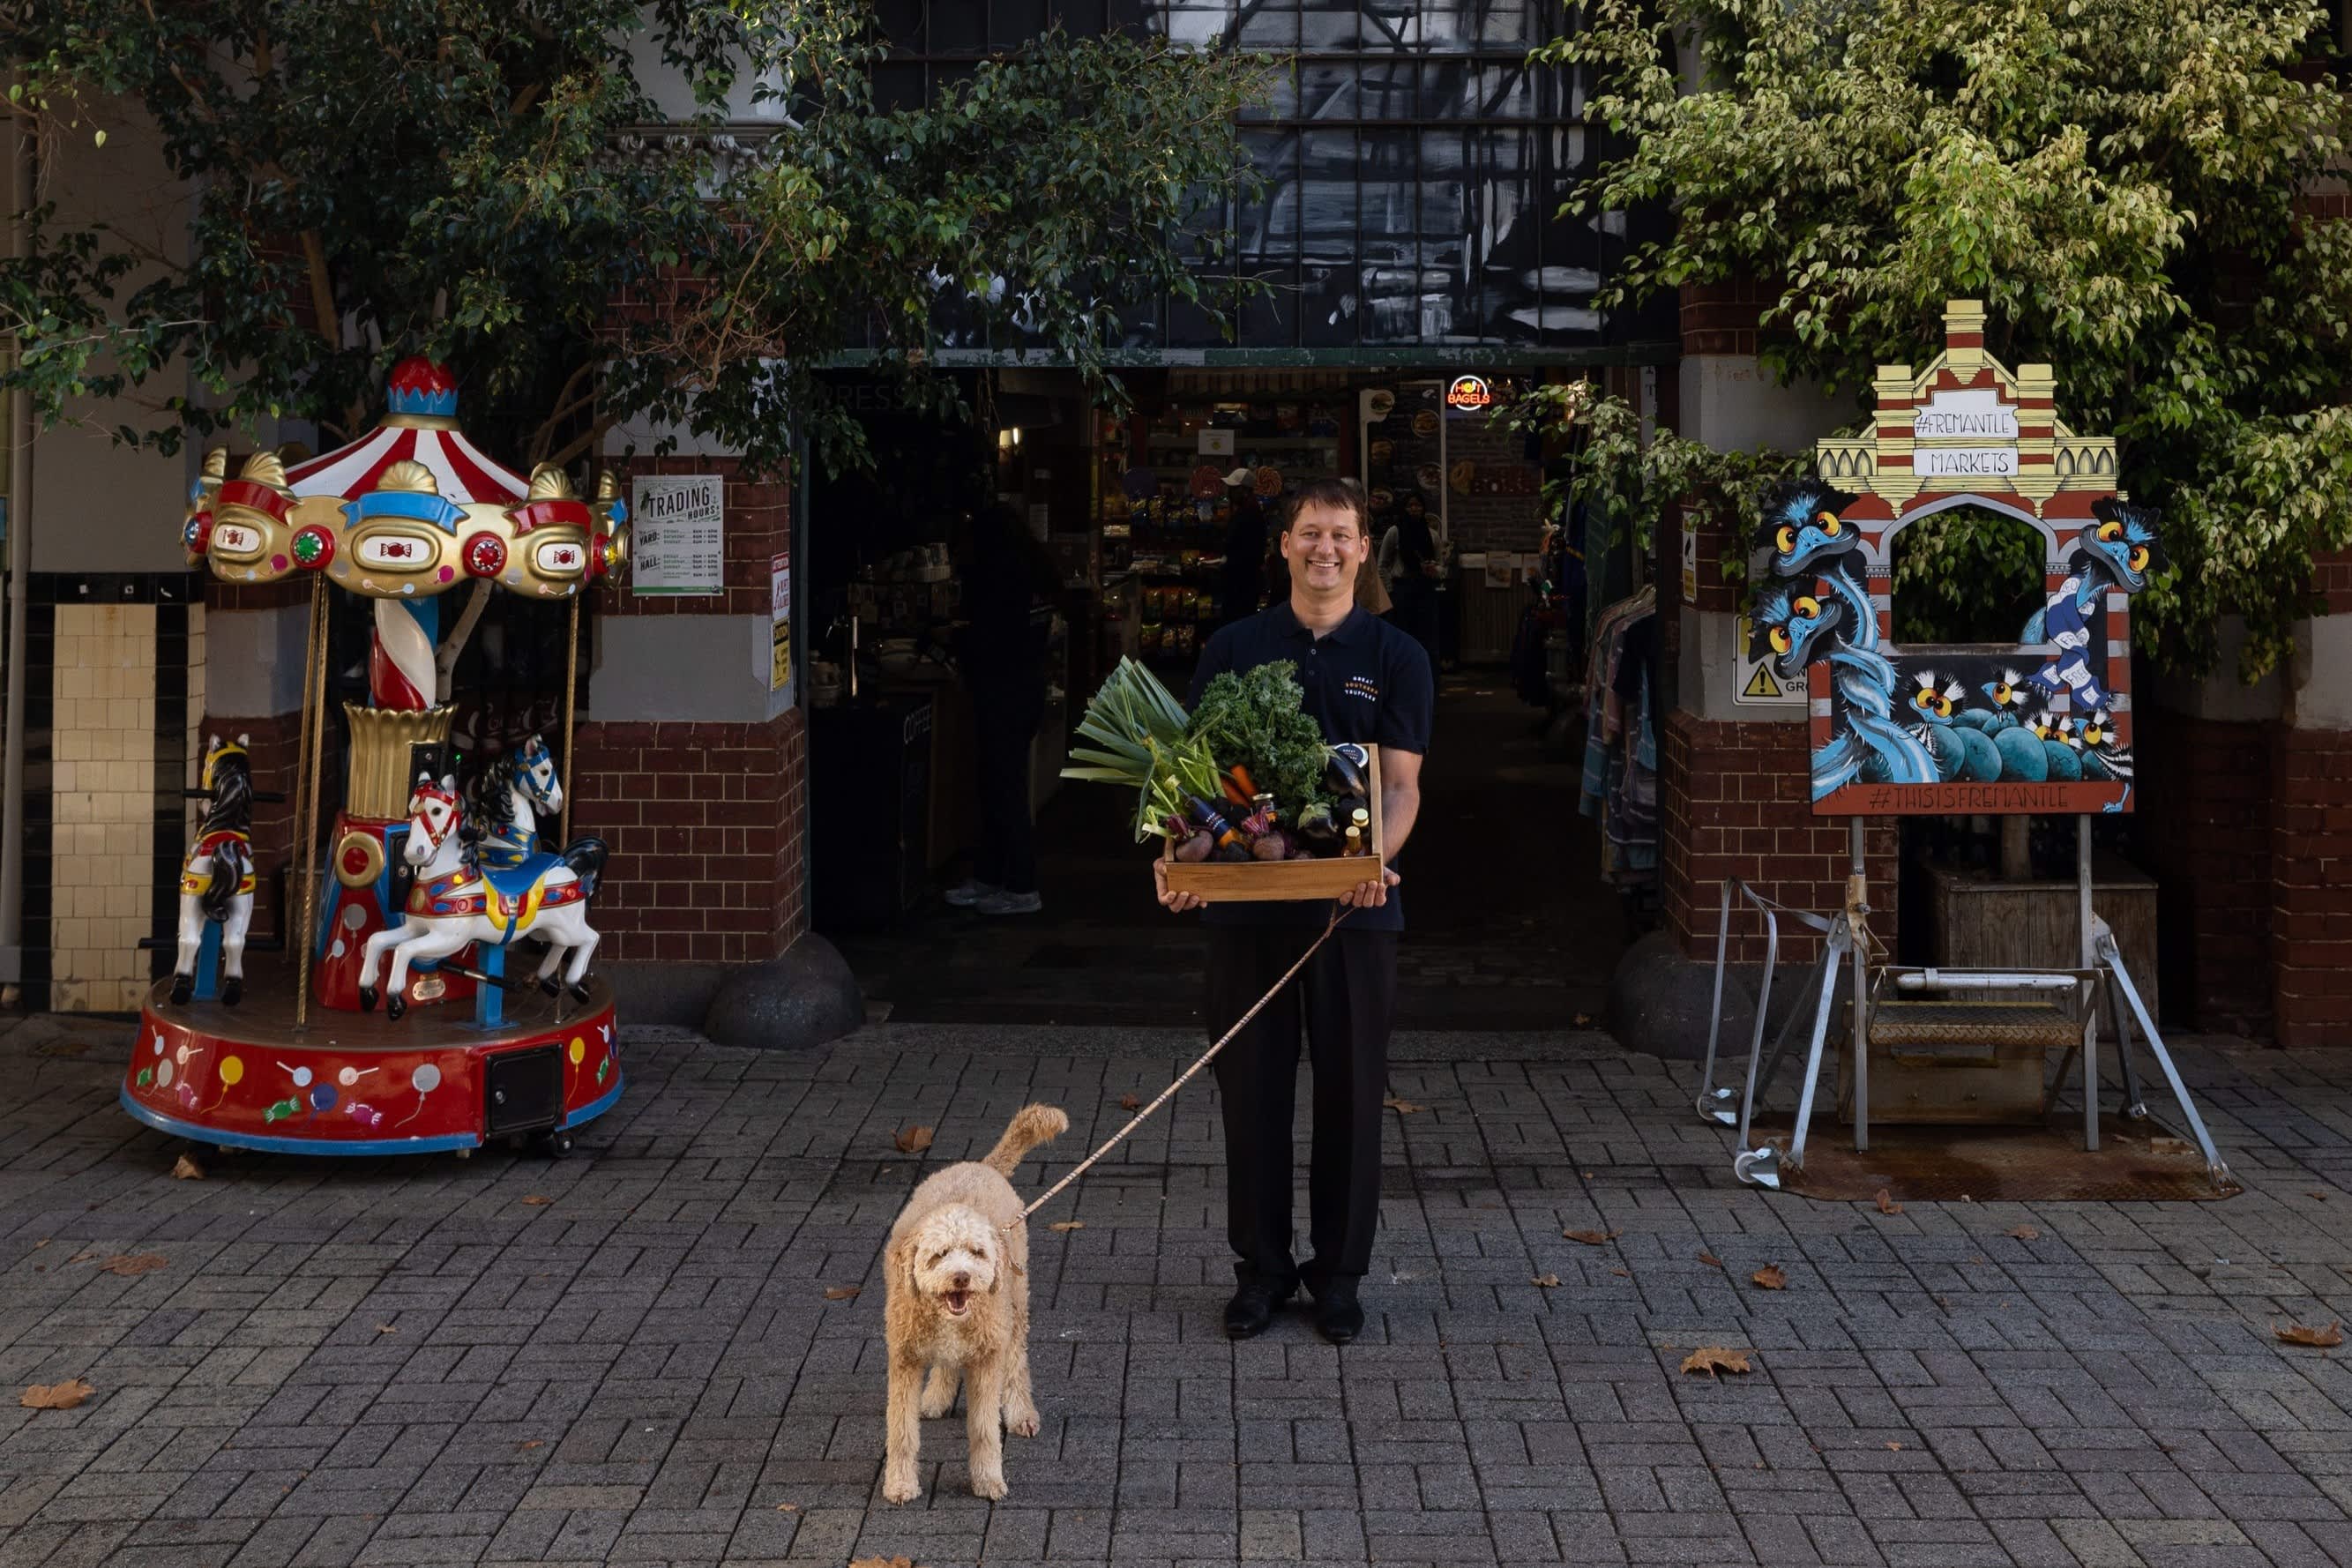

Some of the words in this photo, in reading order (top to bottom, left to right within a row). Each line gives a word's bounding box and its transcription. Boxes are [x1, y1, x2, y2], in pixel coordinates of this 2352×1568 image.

[1455, 382, 1482, 393] HOT
[1447, 393, 1490, 404] BAGELS
[1915, 413, 2010, 434] #FREMANTLE
[1931, 452, 2009, 473] MARKETS
[648, 486, 710, 518] TRADING
[688, 505, 715, 520] HOURS
[639, 532, 661, 546] YARD:
[640, 556, 661, 572] HALL:
[1353, 676, 1374, 685] GREAT
[1786, 682, 1808, 692] GR
[1344, 681, 1379, 695] SOUTHERN
[1344, 689, 1377, 702] TRUFFLES
[1869, 786, 2069, 809] #THISISFREMANTLE
